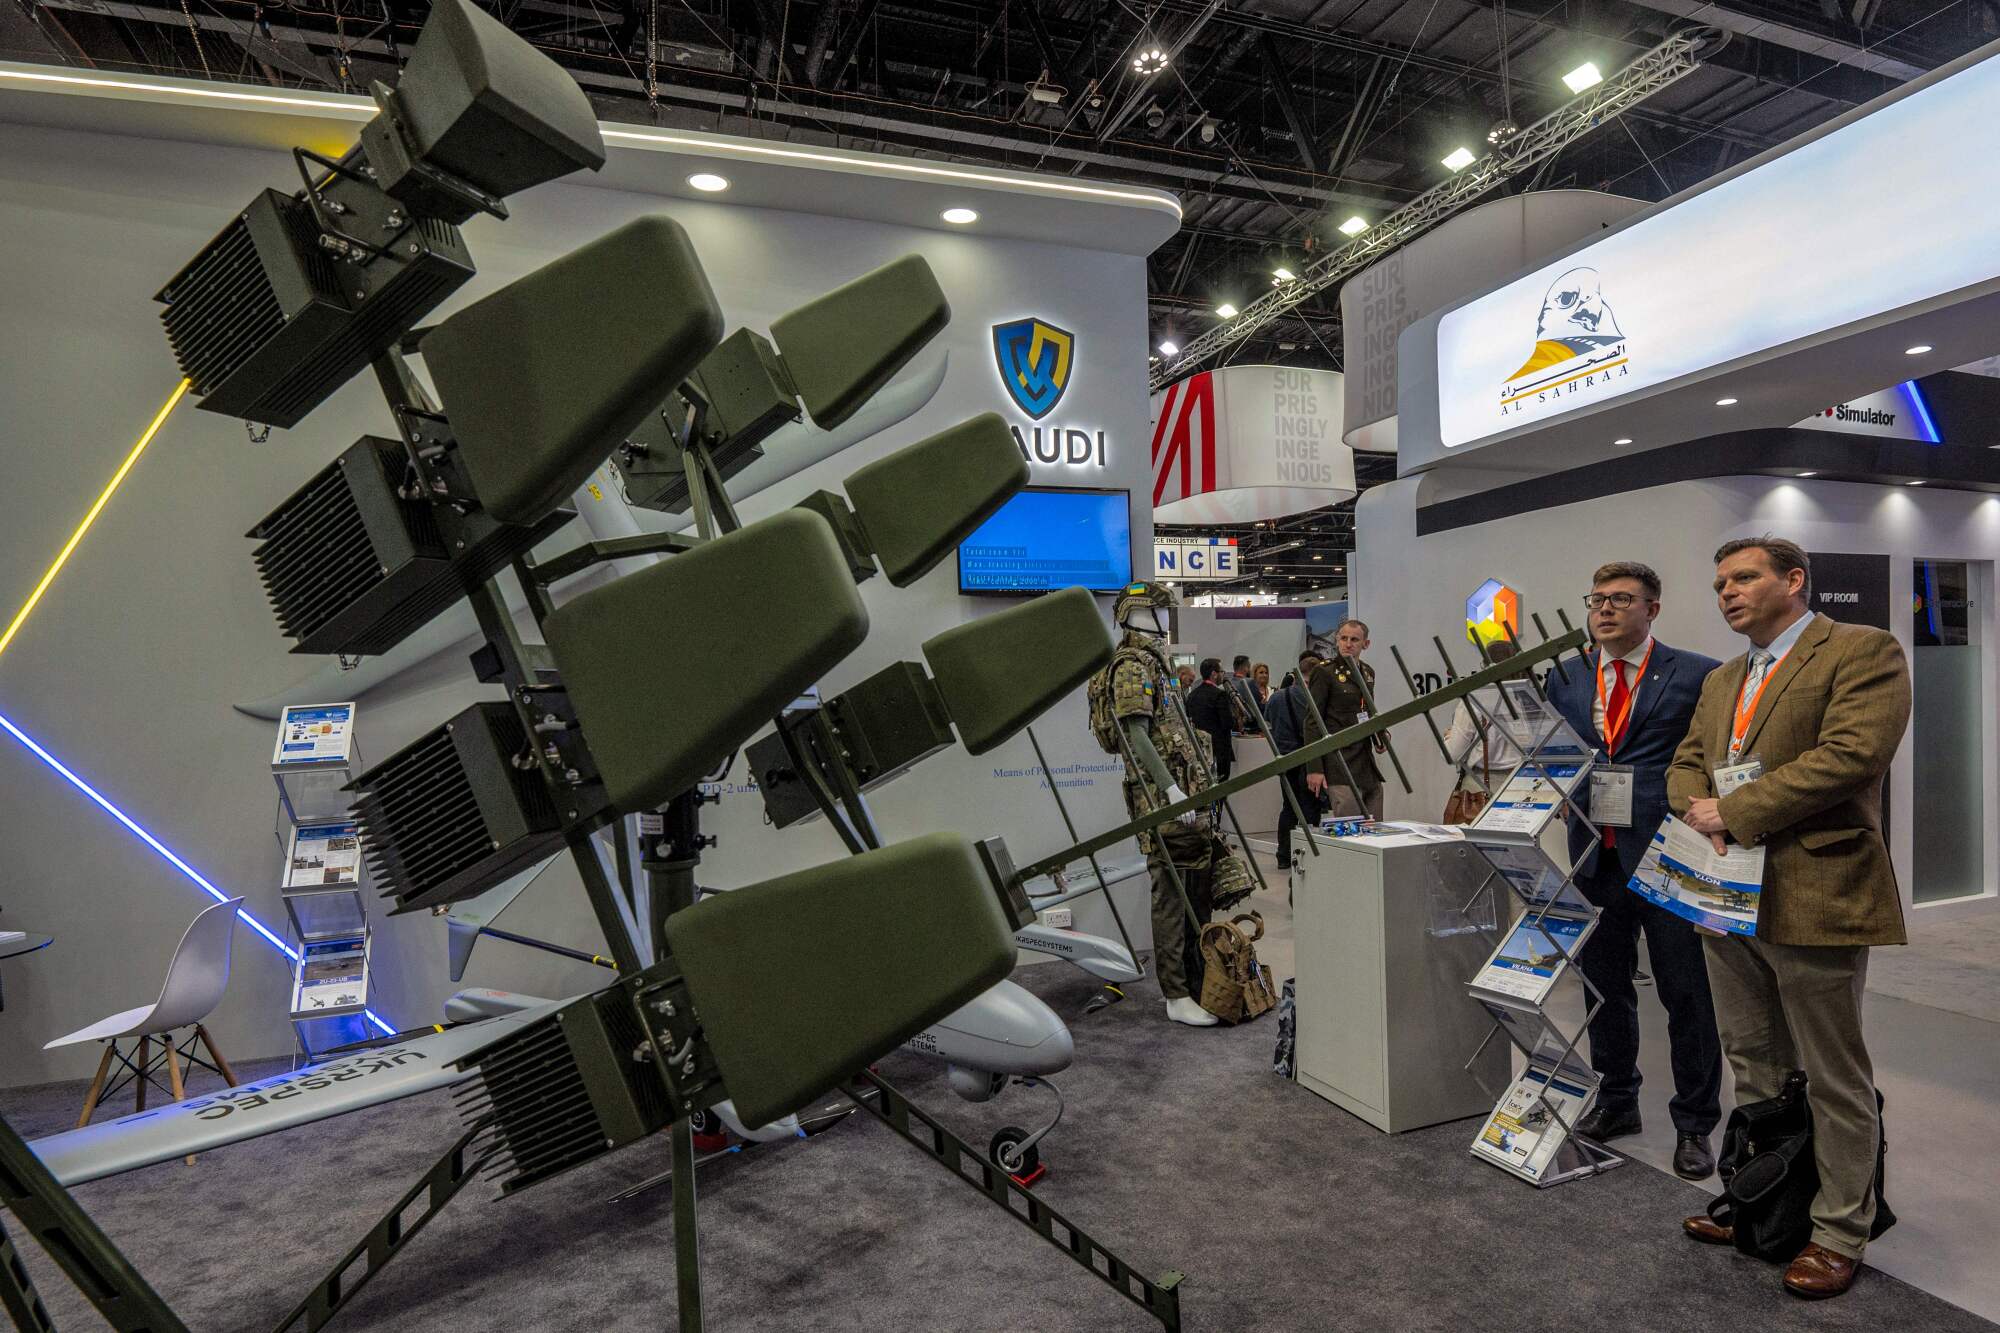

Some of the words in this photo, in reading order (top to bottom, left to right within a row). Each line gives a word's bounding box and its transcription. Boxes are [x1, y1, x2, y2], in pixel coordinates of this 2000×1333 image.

[1362, 260, 1403, 303] SUR
[1364, 286, 1408, 333] PRIS
[1273, 370, 1312, 392] SUR
[1363, 356, 1398, 393] ING
[1501, 344, 1625, 397] الصحراء
[1501, 401, 1522, 416] AL
[1538, 365, 1629, 403] SAHRAA
[1274, 393, 1318, 415] PRIS
[1363, 388, 1398, 420] NIO
[1836, 405, 1895, 426] Simulator
[1274, 416, 1328, 438] INGLY
[1010, 425, 1105, 466] AUDI
[1275, 439, 1320, 460] INGE
[1276, 462, 1332, 483] NIOUS
[1166, 537, 1199, 546] INDUSTRY
[1159, 550, 1232, 570] NCE
[1819, 592, 1833, 603] VIP
[1834, 592, 1858, 603] ROOM
[1413, 673, 1442, 696] 3D
[992, 768, 1023, 777] Means
[1036, 765, 1074, 776] Psonal
[1075, 762, 1119, 774] Protection
[909, 1039, 937, 1053] STEMS
[195, 1052, 427, 1121] UKRSPEC
